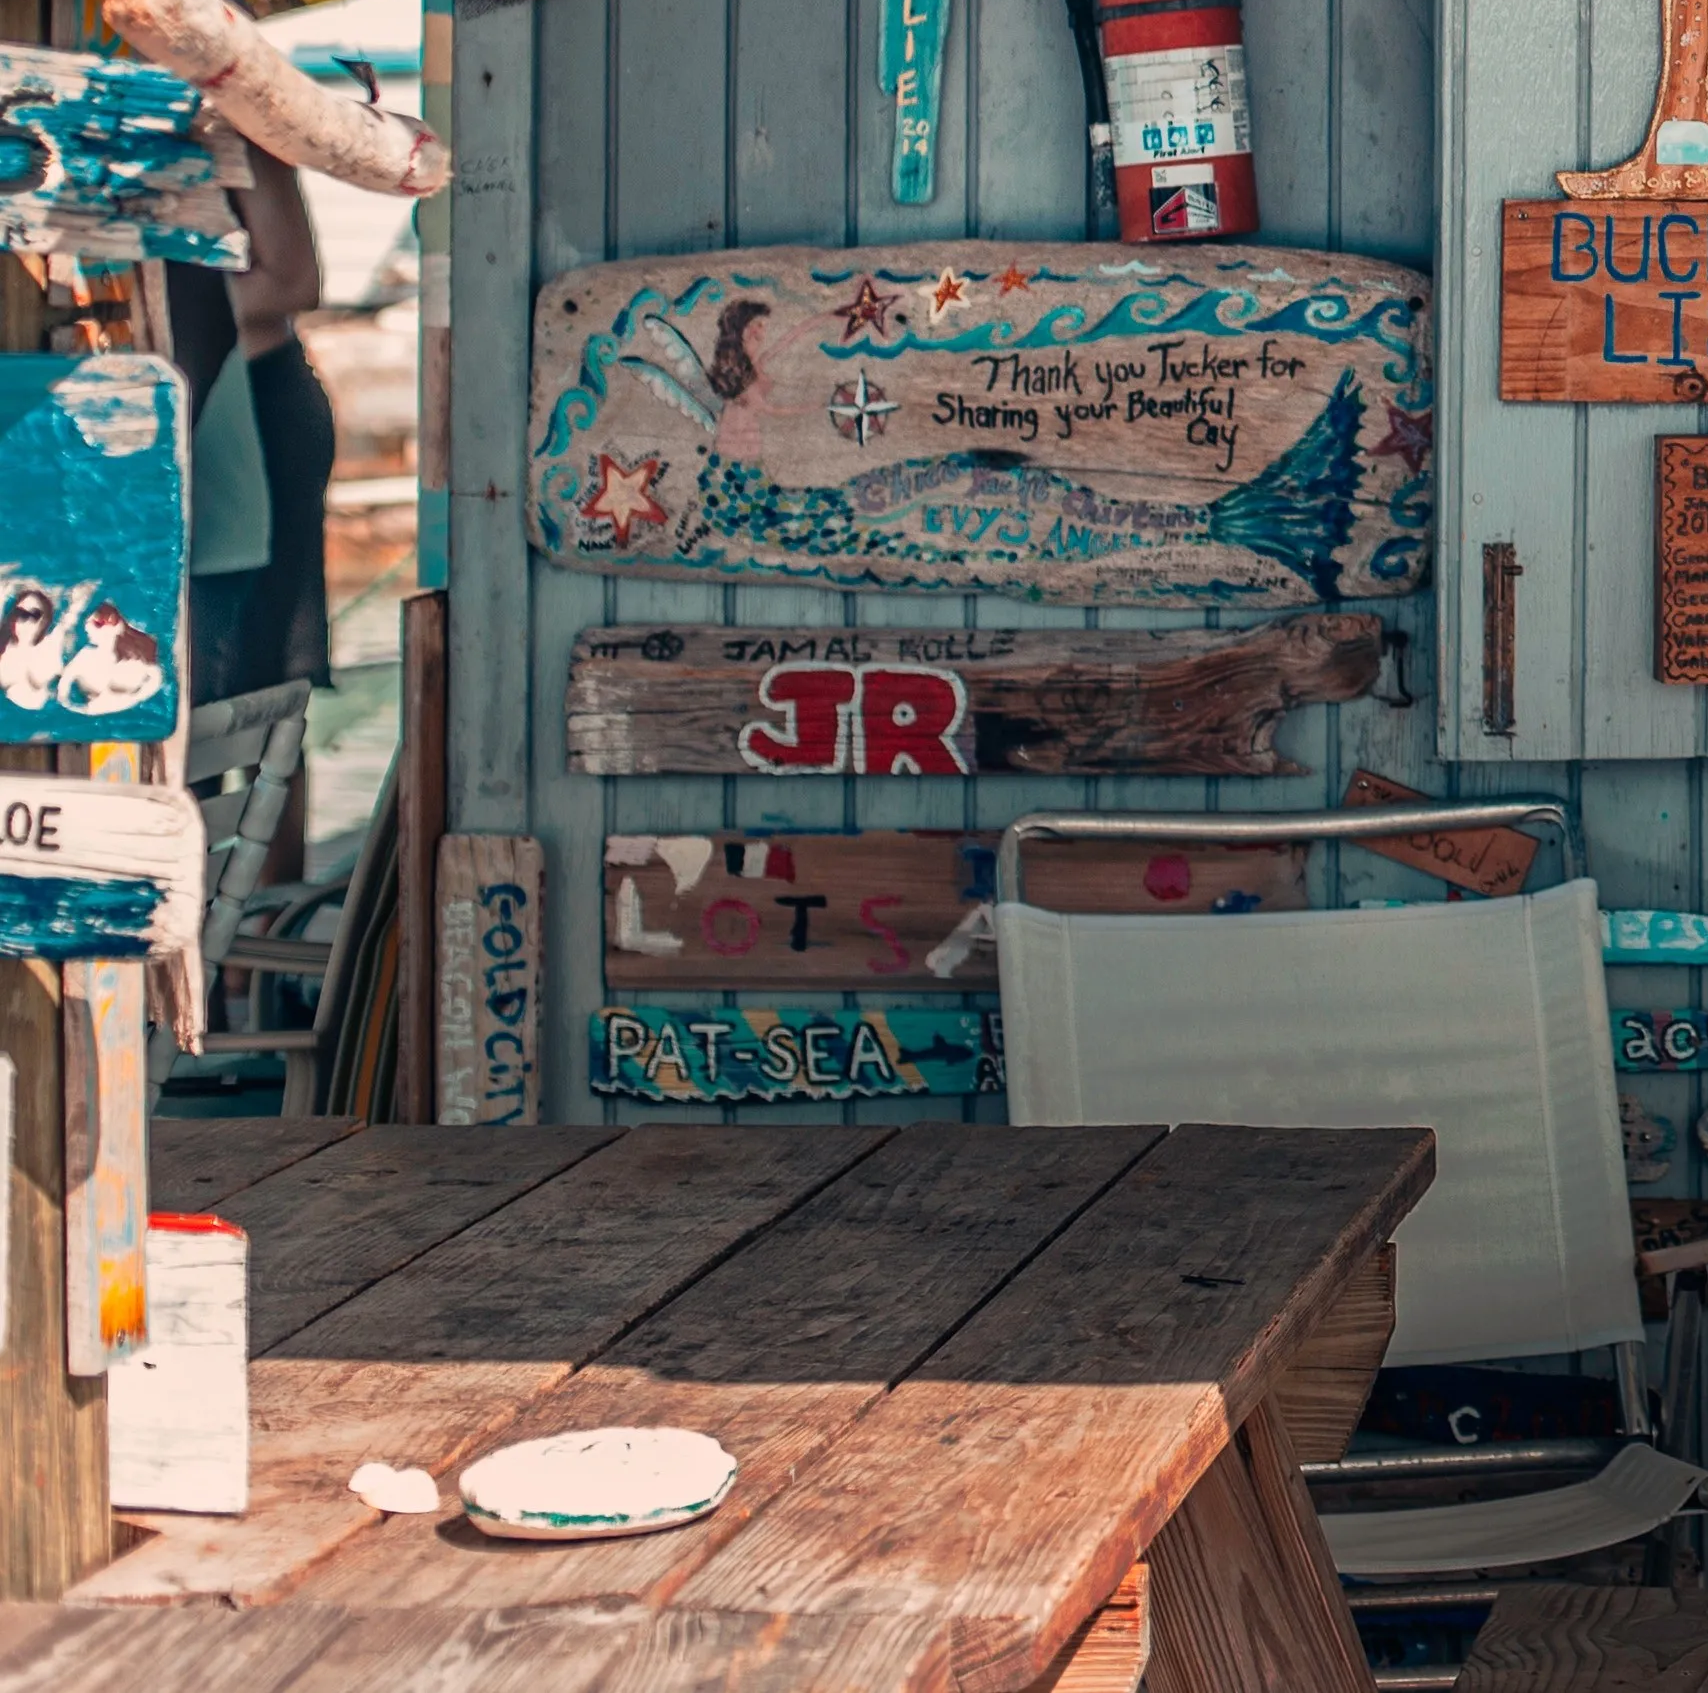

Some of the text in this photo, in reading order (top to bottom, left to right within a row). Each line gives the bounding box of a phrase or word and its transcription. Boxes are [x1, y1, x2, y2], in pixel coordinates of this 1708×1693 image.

[1153, 146, 1179, 159] First
[972, 336, 1308, 405] Thank you Tucker for
[931, 390, 1237, 446] Sharing your Beautiful
[1185, 416, 1241, 472] Cay
[721, 633, 875, 663] JAMAL
[736, 659, 973, 780] JR
[605, 1013, 897, 1085] PAT-SEA
